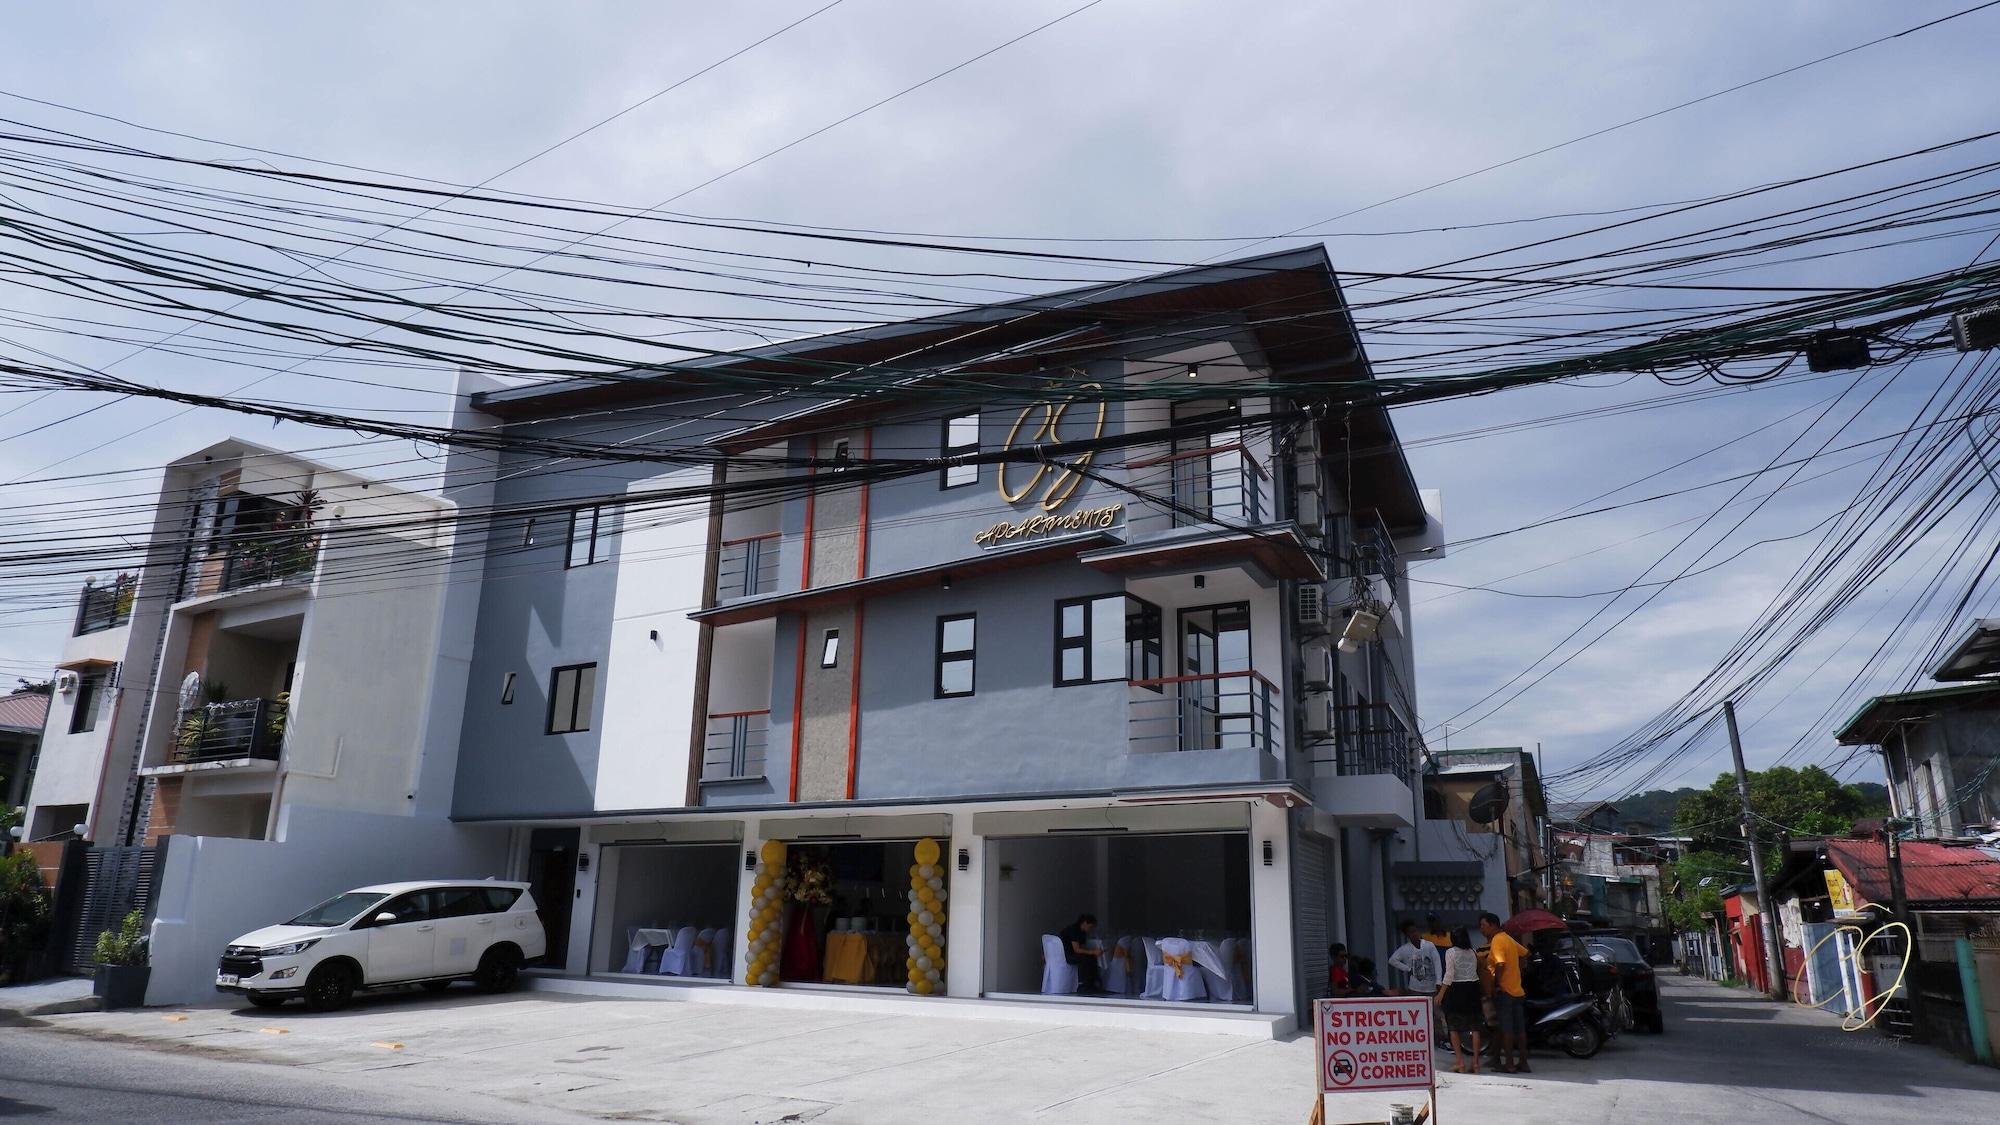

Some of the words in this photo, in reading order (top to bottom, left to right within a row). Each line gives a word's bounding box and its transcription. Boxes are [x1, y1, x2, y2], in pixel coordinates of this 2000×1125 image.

[1331, 1010, 1420, 1027] STRICTLY
[1327, 1031, 1351, 1045] NO
[1356, 1029, 1426, 1044] PARKING
[1359, 1052, 1377, 1063] ON
[1381, 1050, 1427, 1062] STREET
[1361, 1064, 1426, 1079] CORNER
